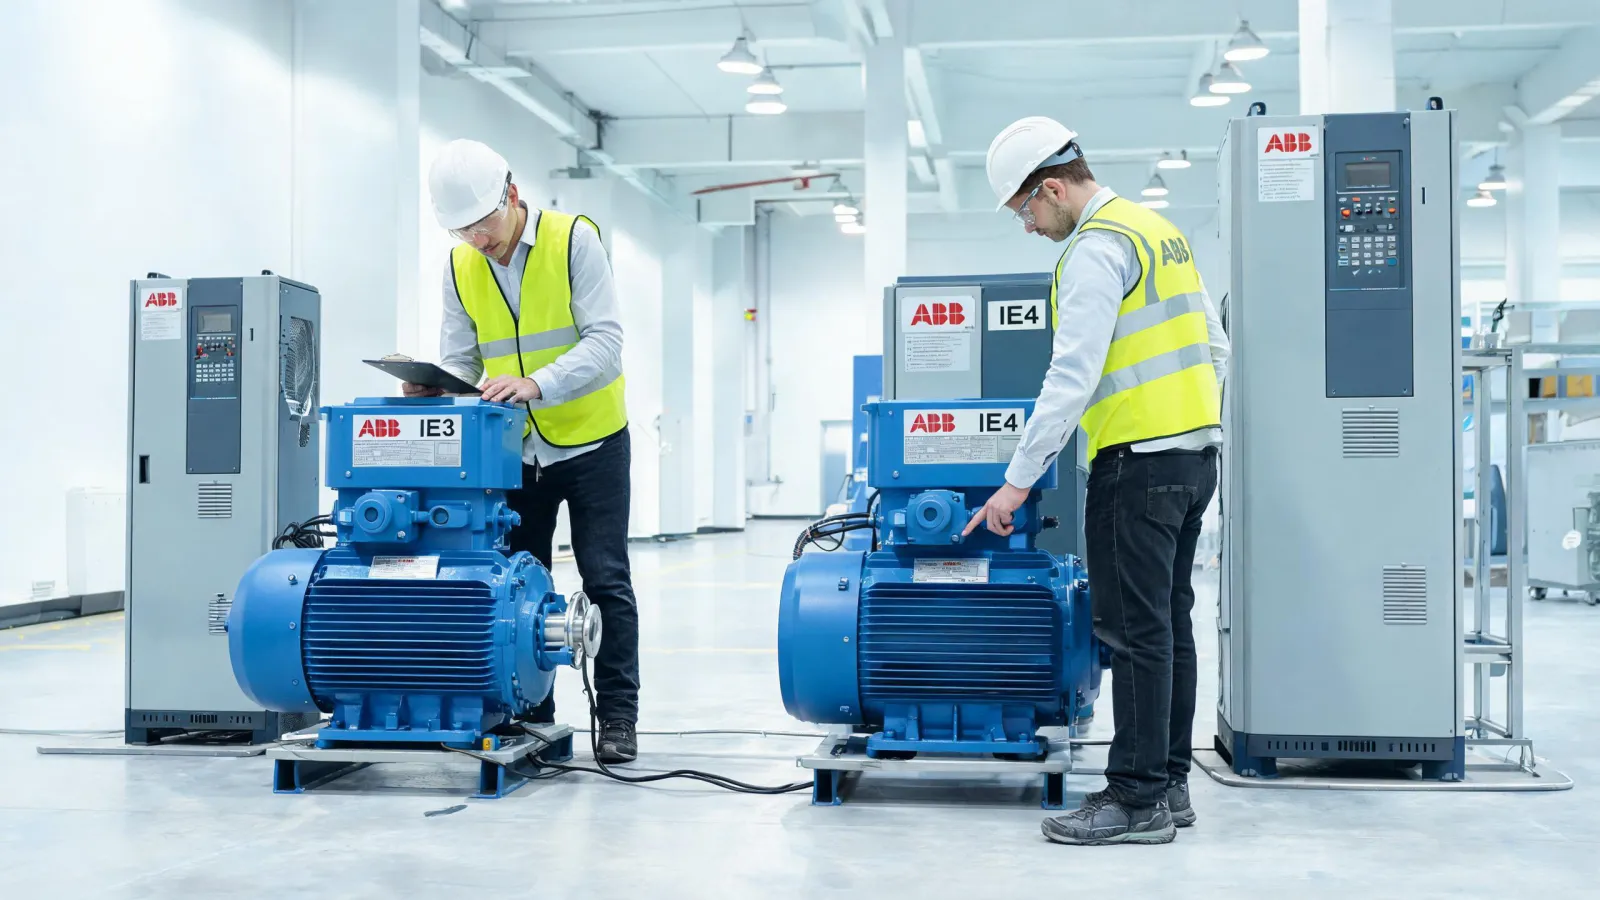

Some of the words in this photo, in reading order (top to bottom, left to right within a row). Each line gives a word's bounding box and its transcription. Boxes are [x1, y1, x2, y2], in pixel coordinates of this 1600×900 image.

[1264, 133, 1312, 153] ABB
[1160, 237, 1190, 266] ABB
[145, 292, 177, 307] ABB
[910, 302, 966, 326] ABB
[1000, 305, 1039, 325] IE4
[358, 419, 401, 437] ABB
[420, 418, 455, 437] IE3
[910, 413, 956, 433] ABB
[979, 413, 1018, 432] IE4
